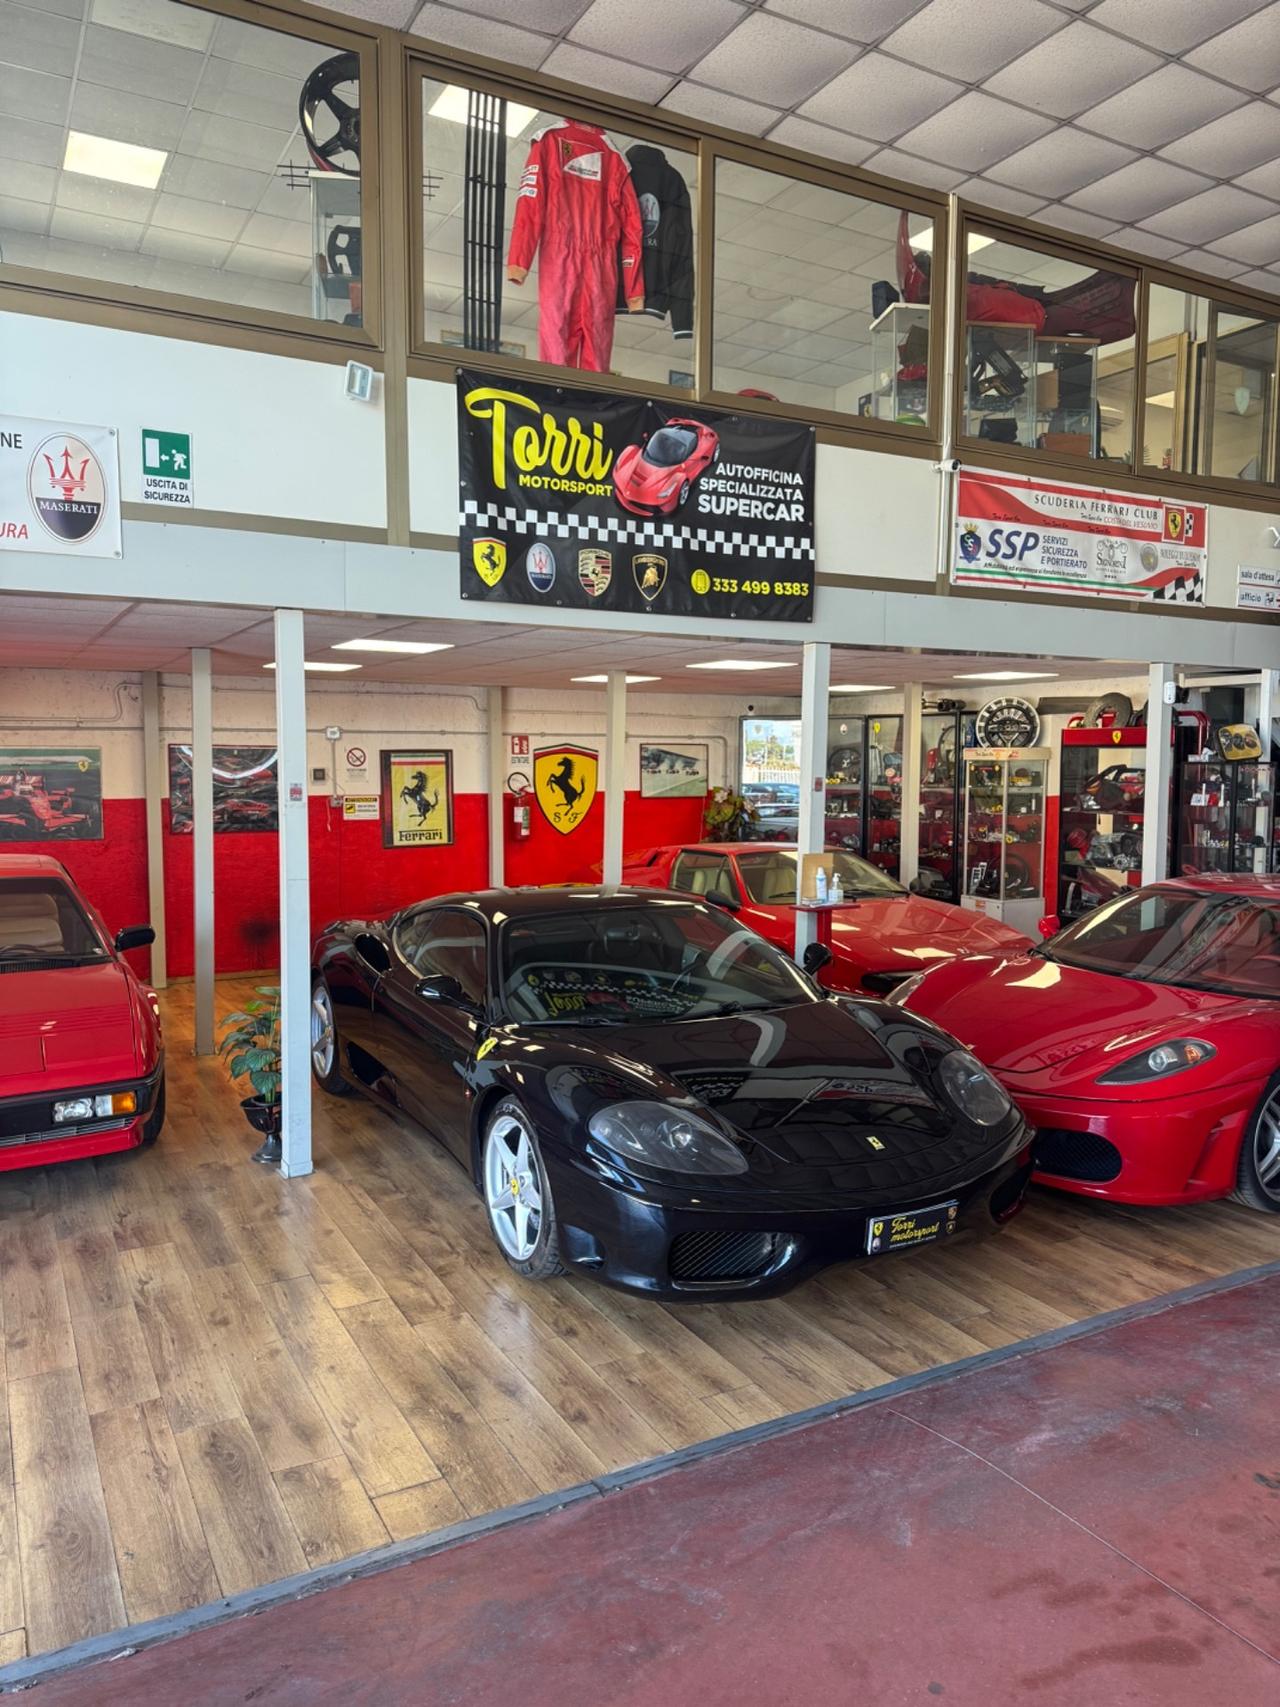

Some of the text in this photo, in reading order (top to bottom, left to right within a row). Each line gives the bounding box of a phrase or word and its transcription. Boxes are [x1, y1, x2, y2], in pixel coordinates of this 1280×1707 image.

[464, 387, 613, 490] Torri
[715, 462, 804, 486] AUTOFFICINA
[146, 478, 188, 491] USCITA DI
[519, 474, 613, 496] MOTORSPORT
[699, 477, 804, 501] SPECIALIZZATA
[144, 490, 191, 504] SICUREZZA
[40, 501, 98, 515] MASERATI
[697, 494, 805, 522] SUPERCAR
[1034, 494, 1158, 520] SCUDERIA FERRARI CLUB
[985, 528, 1040, 561] SSP
[1042, 535, 1068, 546] SERVIZI
[1041, 546, 1079, 558] SICUREZZA
[1040, 556, 1045, 565] E
[1046, 557, 1088, 569] PORTIERATO
[712, 578, 809, 597] 333 499 8383
[398, 829, 443, 842] Ferrari
